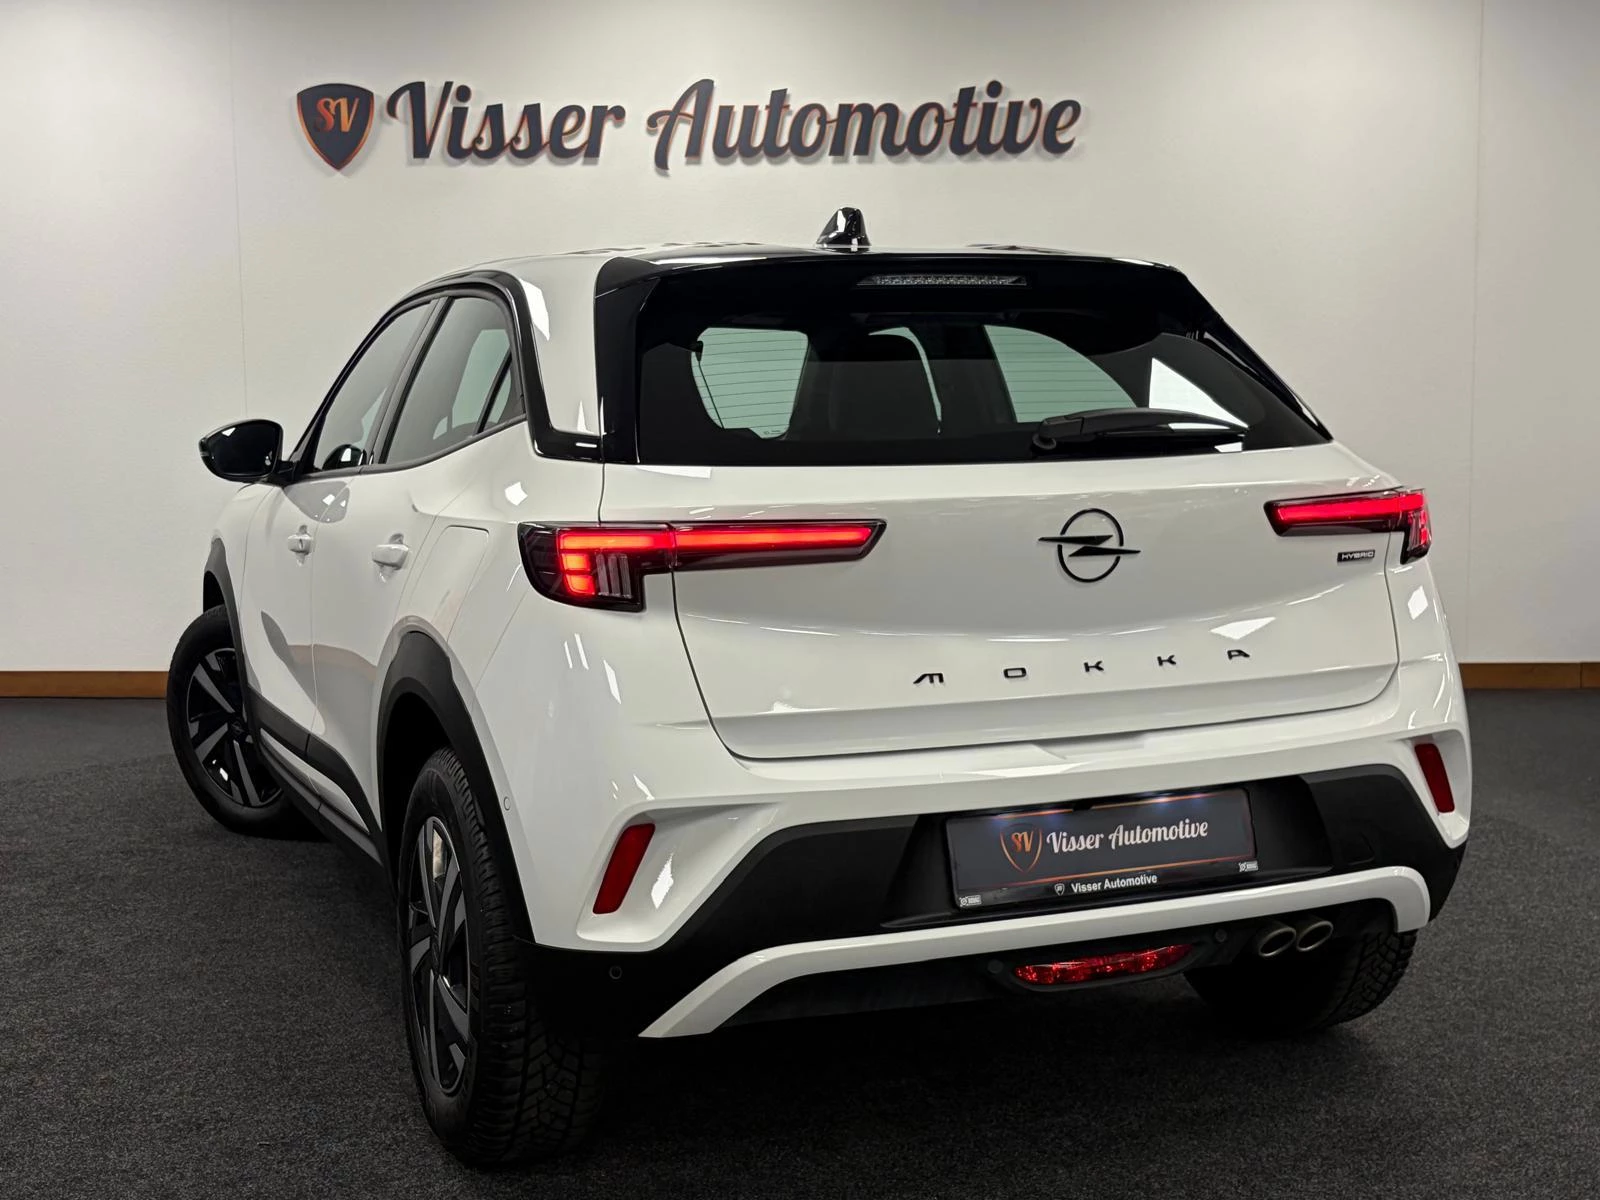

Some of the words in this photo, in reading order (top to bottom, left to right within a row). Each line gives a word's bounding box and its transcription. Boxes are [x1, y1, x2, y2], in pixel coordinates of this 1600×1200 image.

[386, 81, 626, 160] Visser
[646, 78, 1082, 171] Automotive
[913, 649, 1250, 685] MOKKA
[1046, 831, 1104, 853] Visser
[1108, 818, 1209, 850] Automotive
[1071, 881, 1102, 893] Visser
[1104, 874, 1158, 889] Automotive
